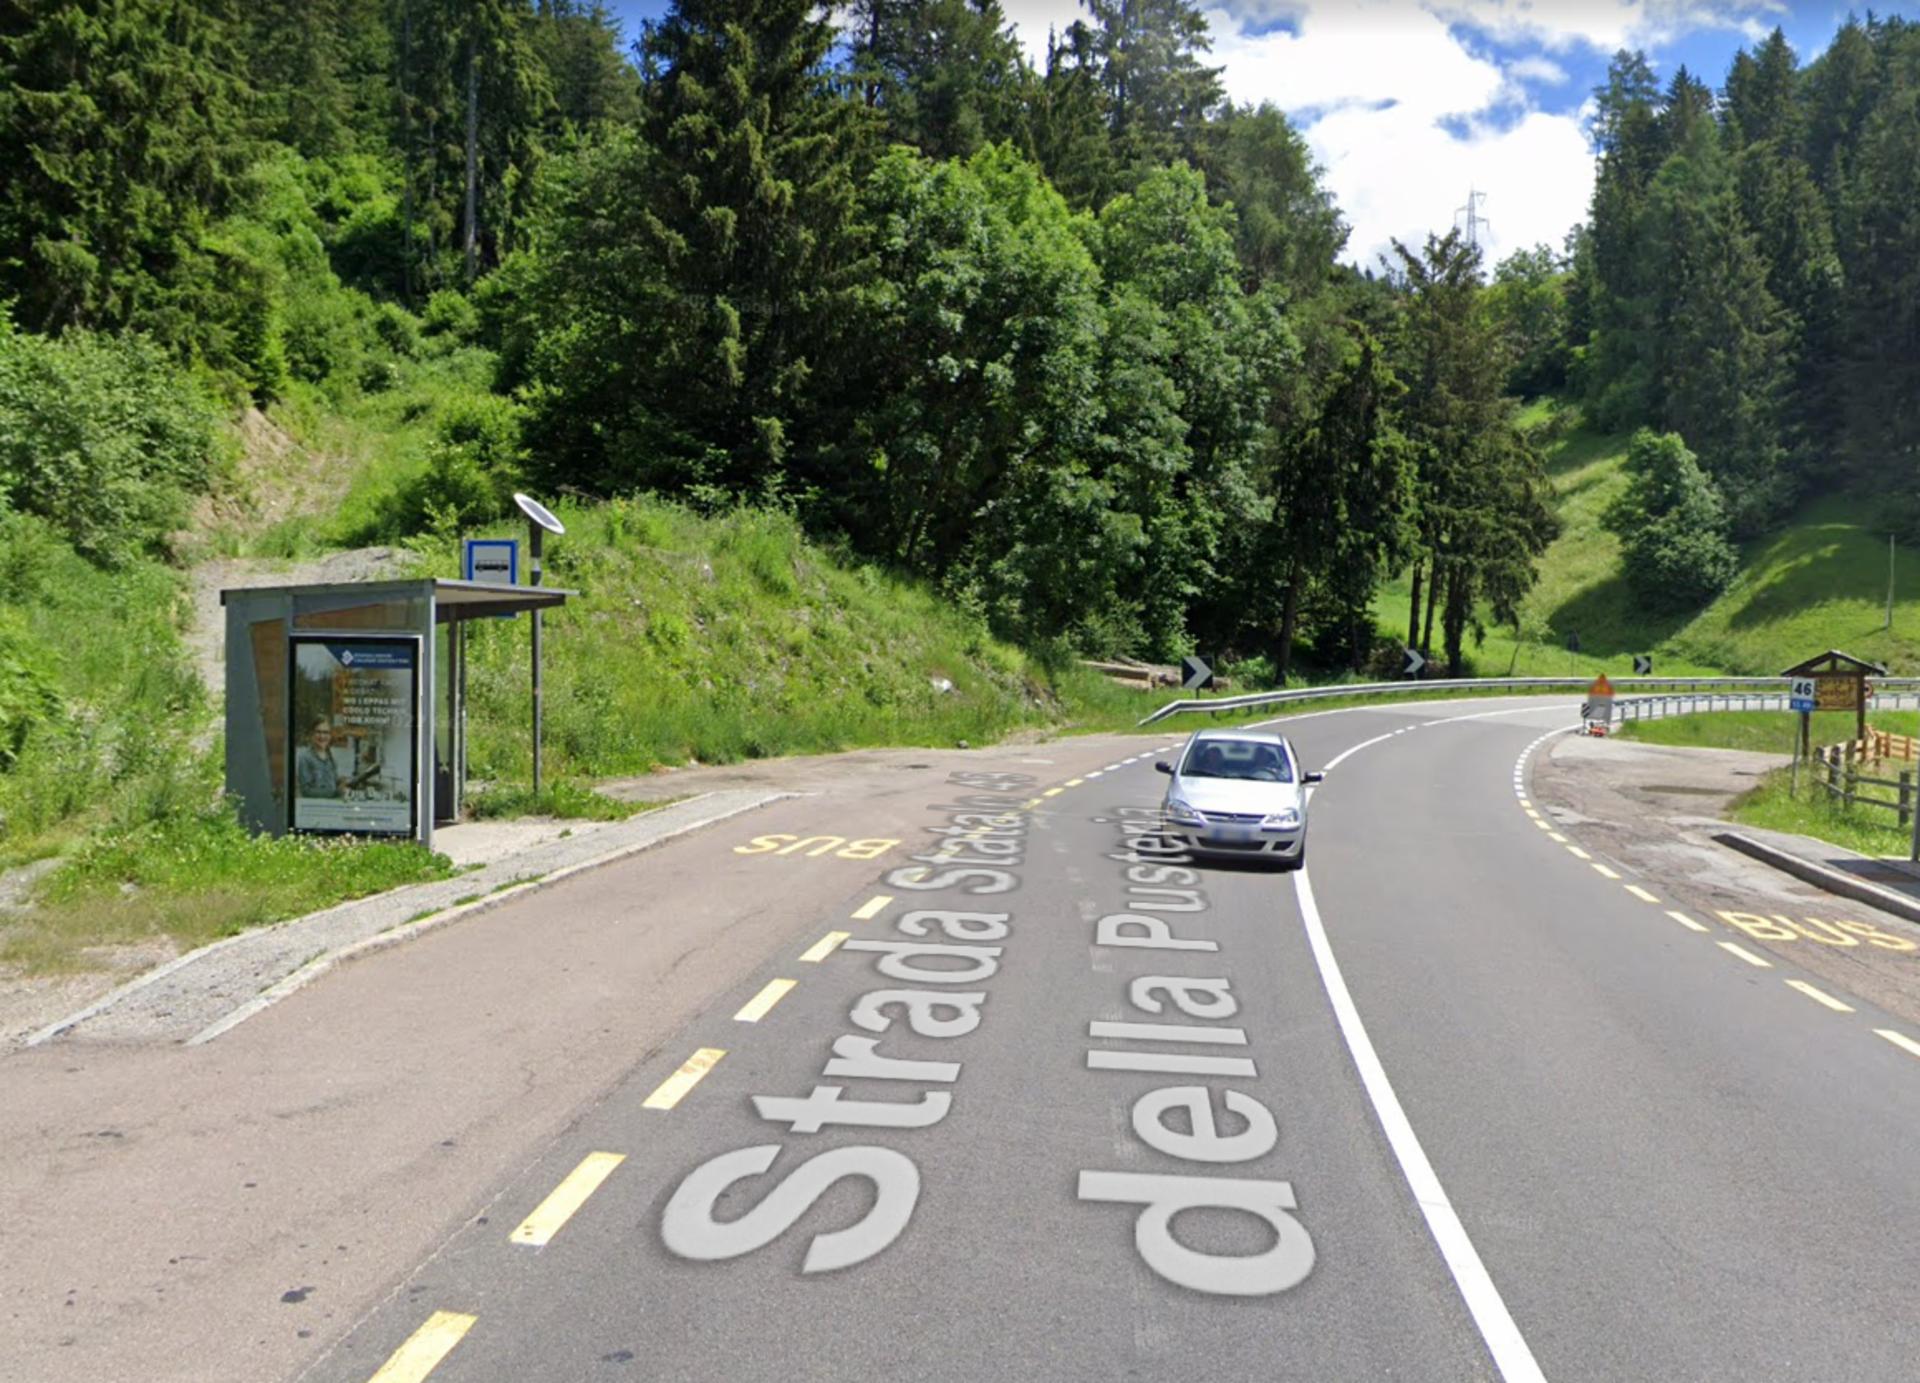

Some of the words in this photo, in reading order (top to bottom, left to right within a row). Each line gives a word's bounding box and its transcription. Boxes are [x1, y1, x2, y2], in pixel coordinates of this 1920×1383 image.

[1794, 682, 1812, 696] 46
[733, 834, 902, 860] BUS
[1714, 909, 1918, 951] BUS
